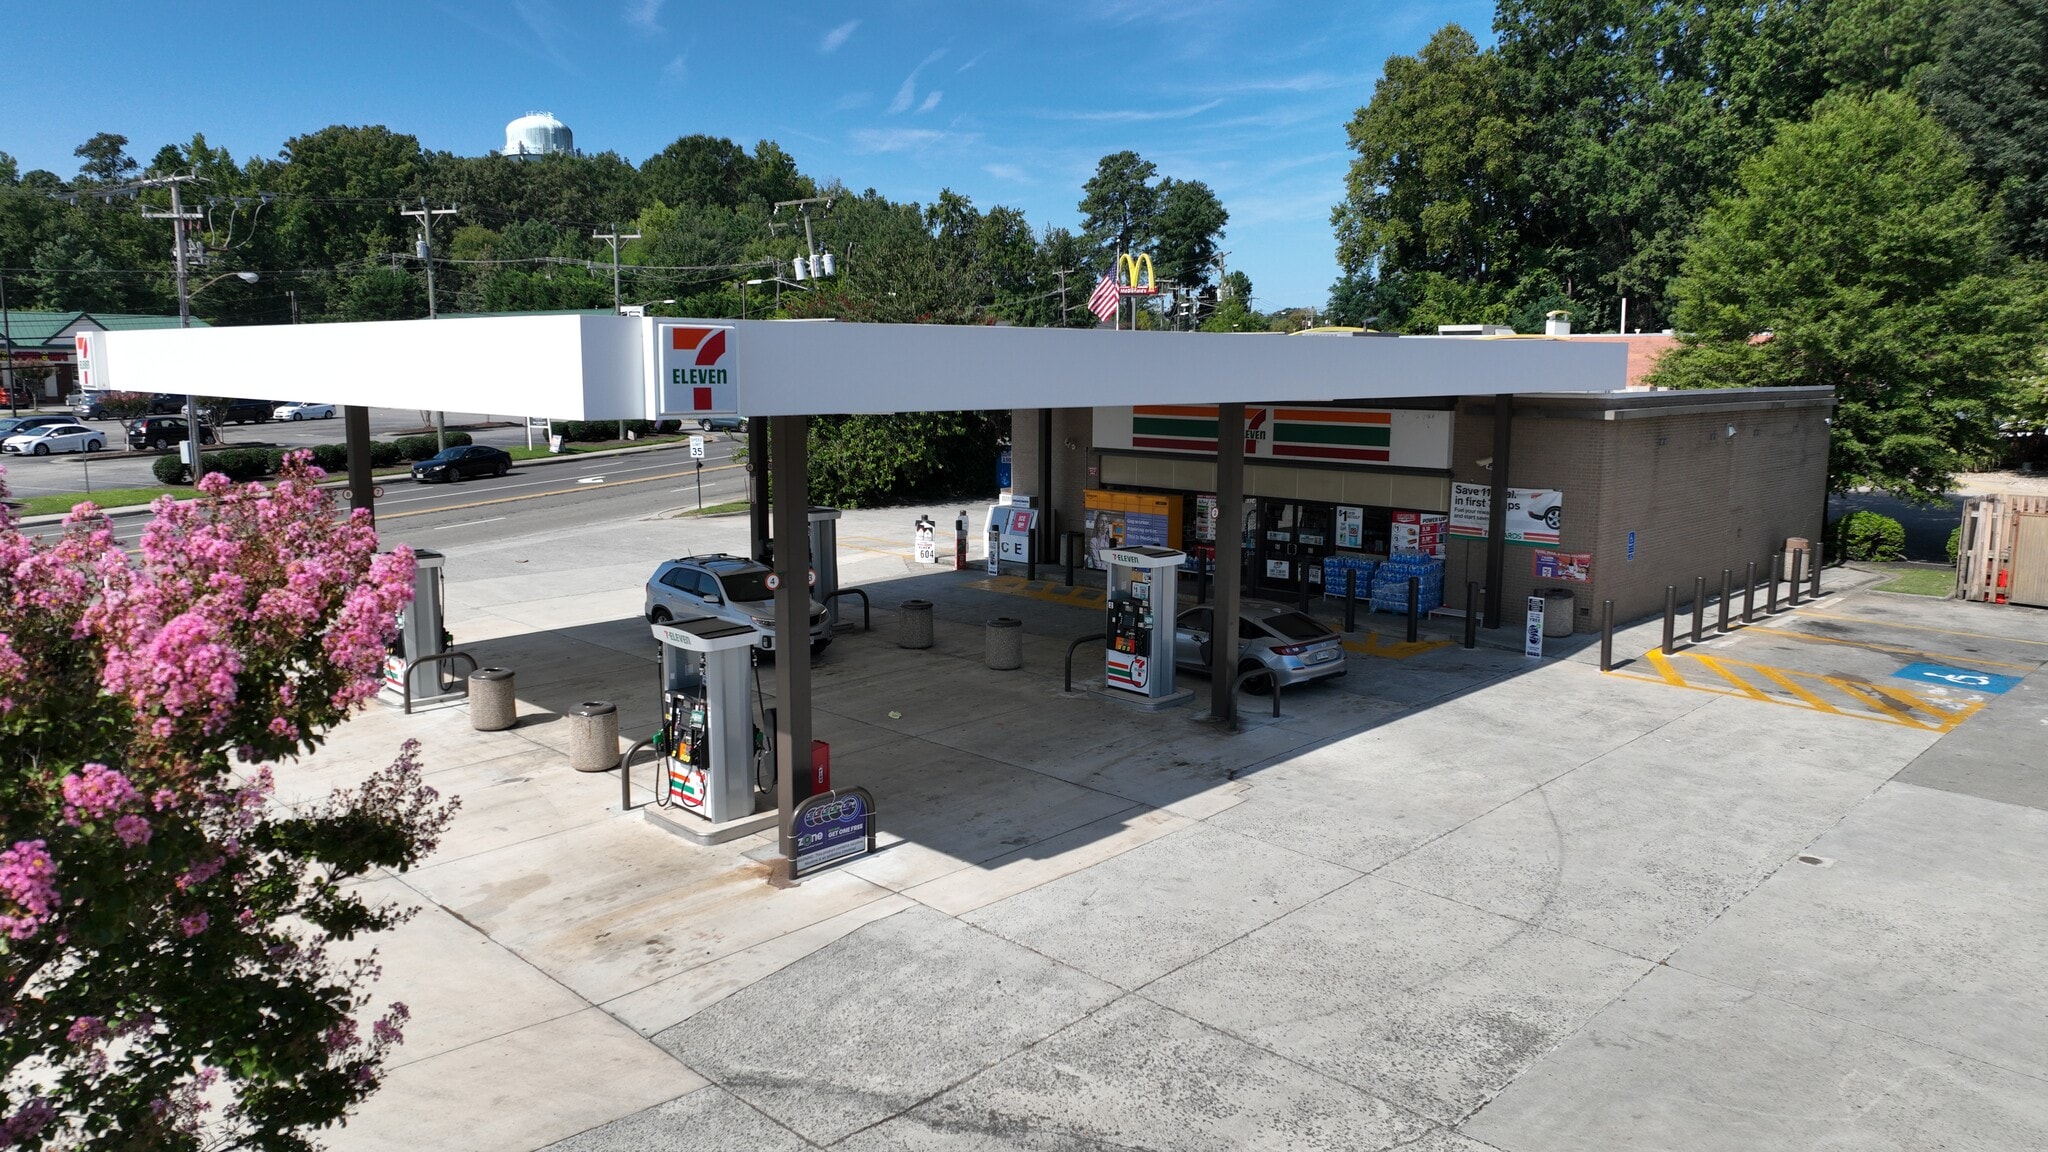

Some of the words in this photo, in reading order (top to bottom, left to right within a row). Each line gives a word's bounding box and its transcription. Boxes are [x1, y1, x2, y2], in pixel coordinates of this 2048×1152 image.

[1244, 430, 1265, 440] EVEn
[692, 447, 703, 456] 35
[1455, 484, 1479, 496] Save
[1455, 496, 1464, 505] in
[1465, 497, 1486, 508] first
[919, 549, 933, 559] 604
[770, 577, 776, 585] 4
[839, 827, 850, 835] ONE
[851, 823, 863, 831] FREE
